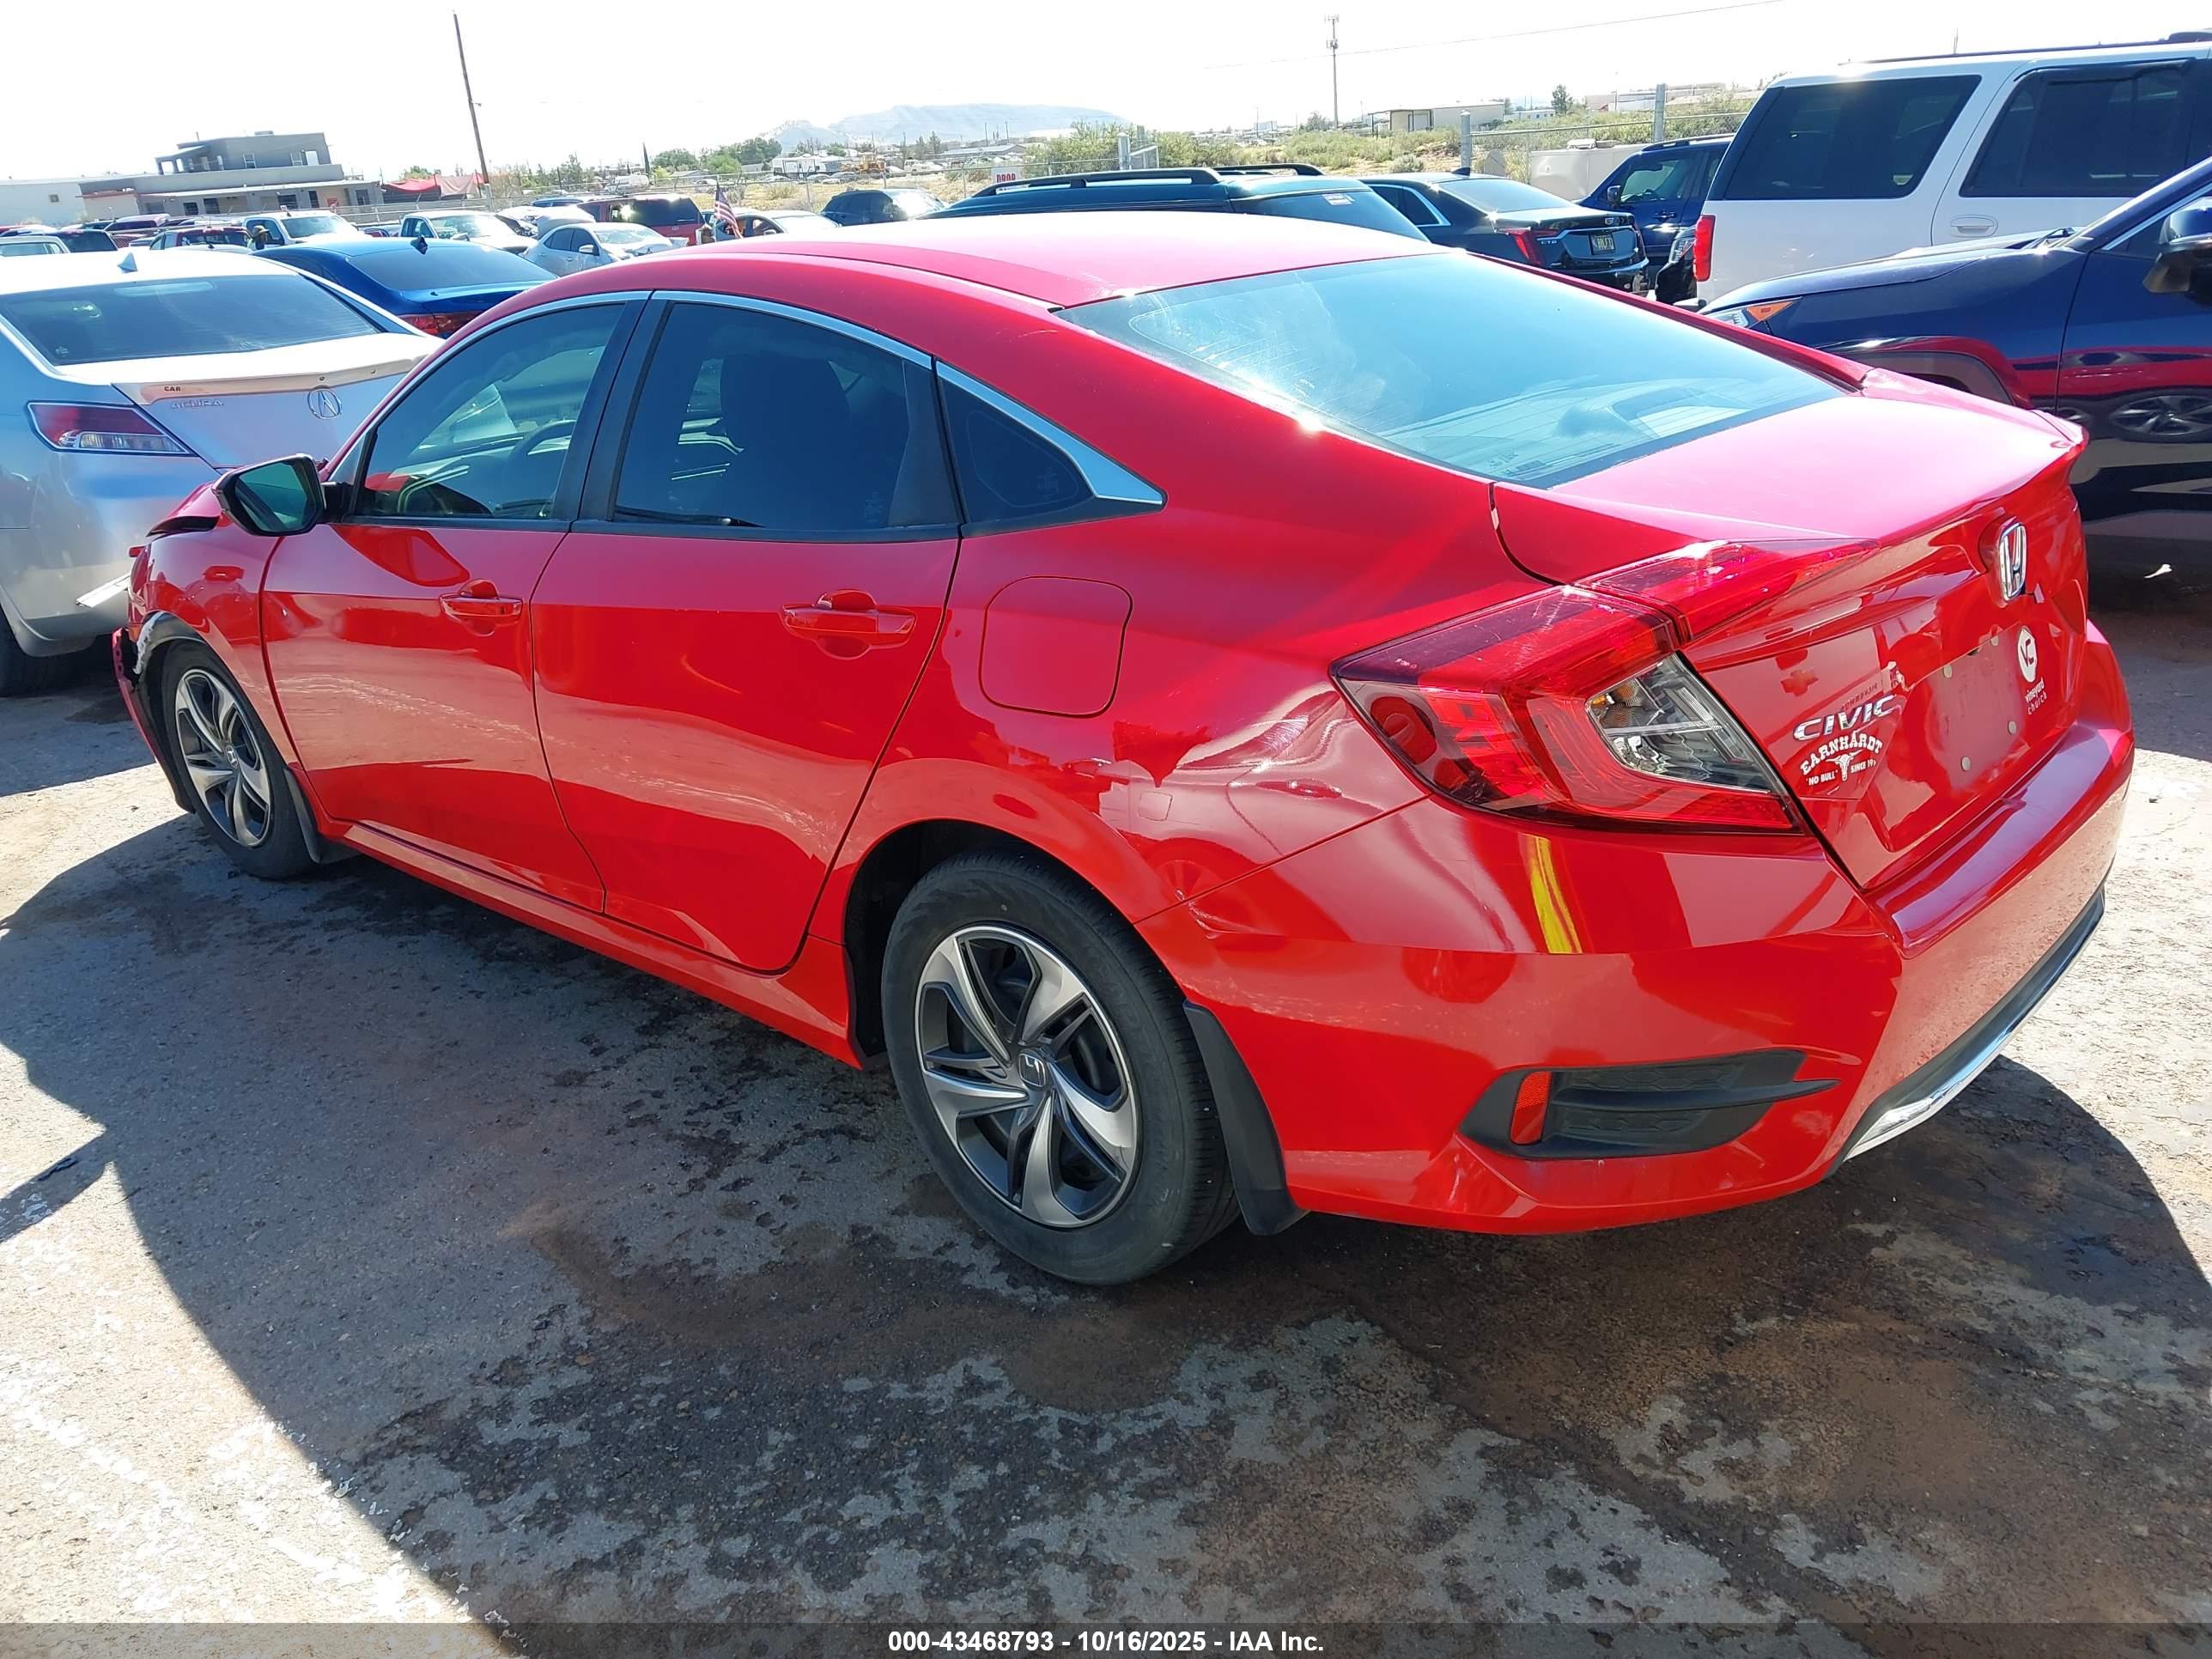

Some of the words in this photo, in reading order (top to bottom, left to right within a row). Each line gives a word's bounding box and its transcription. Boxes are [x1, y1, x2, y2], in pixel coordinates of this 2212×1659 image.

[172, 398, 224, 410] ACURA
[2027, 690, 2047, 714] church
[1793, 694, 1897, 741] CIVIC
[1800, 732, 1883, 775] EARNHARDT
[1850, 761, 1867, 774] SINCE
